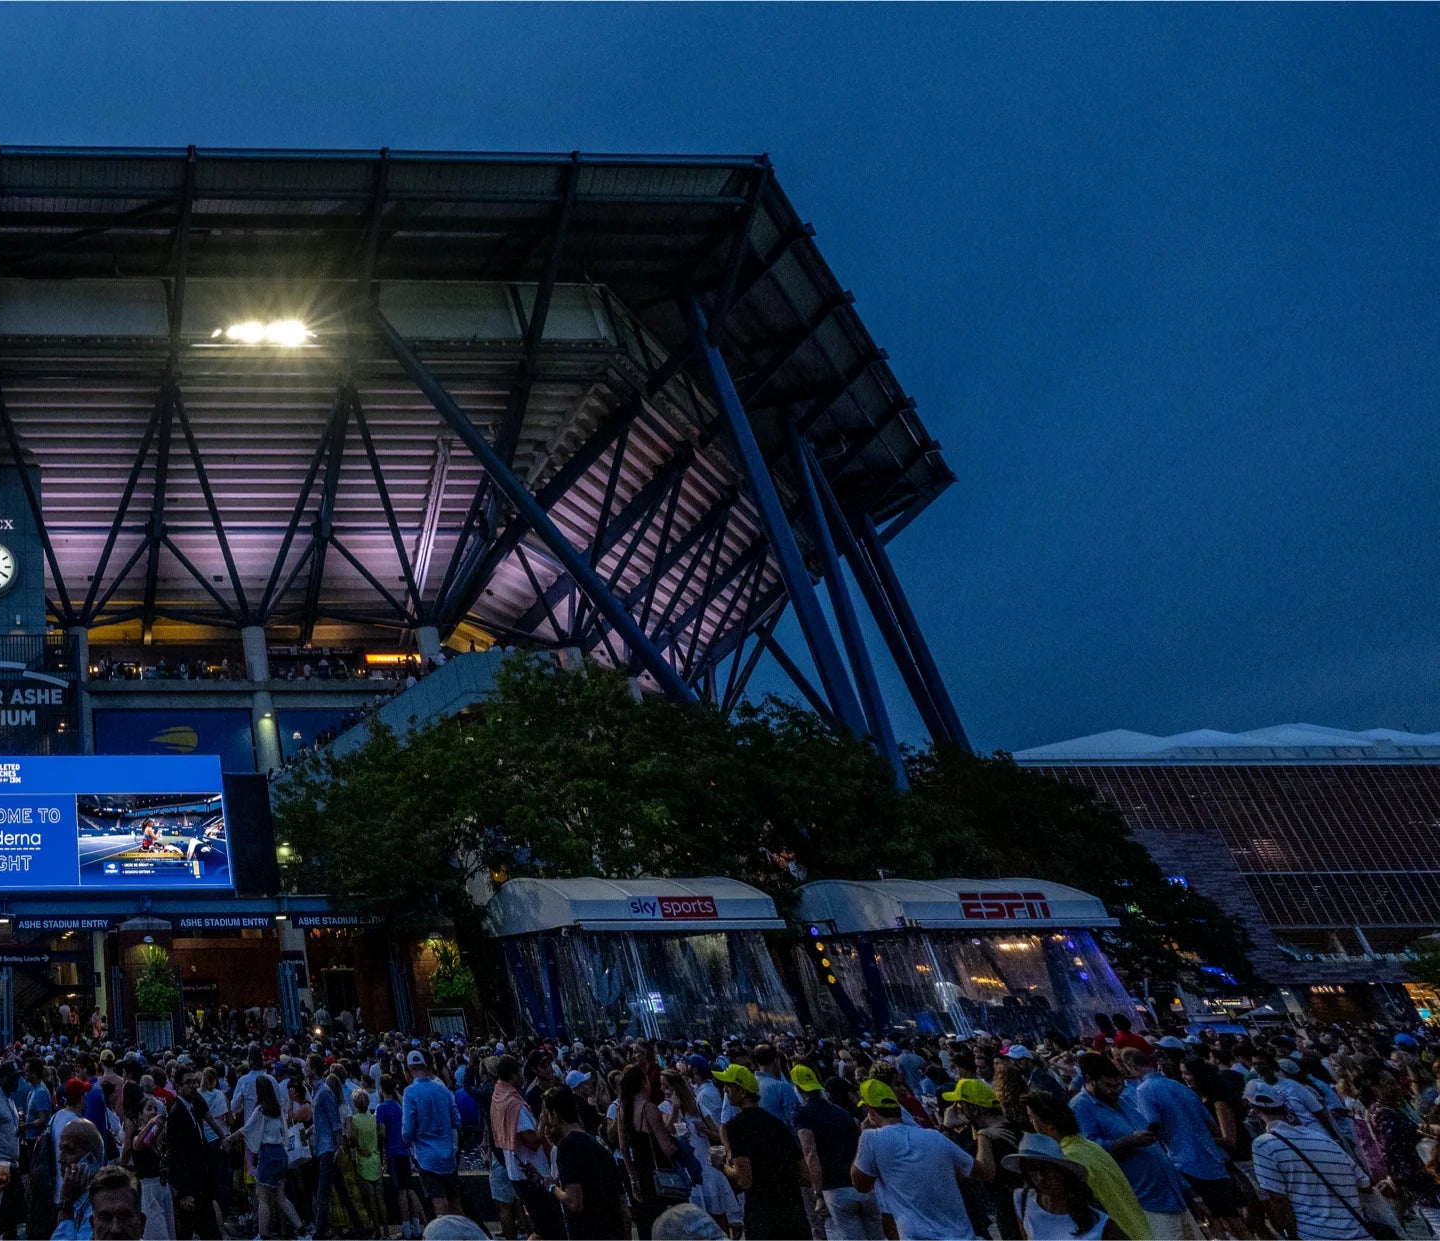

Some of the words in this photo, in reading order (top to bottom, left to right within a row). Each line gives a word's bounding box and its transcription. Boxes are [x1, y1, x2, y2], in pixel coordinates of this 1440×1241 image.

[10, 688, 62, 705] ASHE
[38, 808, 61, 823] TO
[630, 898, 656, 917] sky
[662, 900, 714, 916] sports
[959, 892, 1052, 919] ESPN
[18, 920, 42, 929] ASHE
[43, 920, 80, 929] STADIUM
[81, 920, 108, 929] ENTRY
[180, 918, 203, 926] ASHE
[204, 918, 240, 926] STADIUM
[242, 918, 269, 926] ENTRY
[298, 917, 320, 925] ASHE
[322, 916, 358, 925] STADIUM
